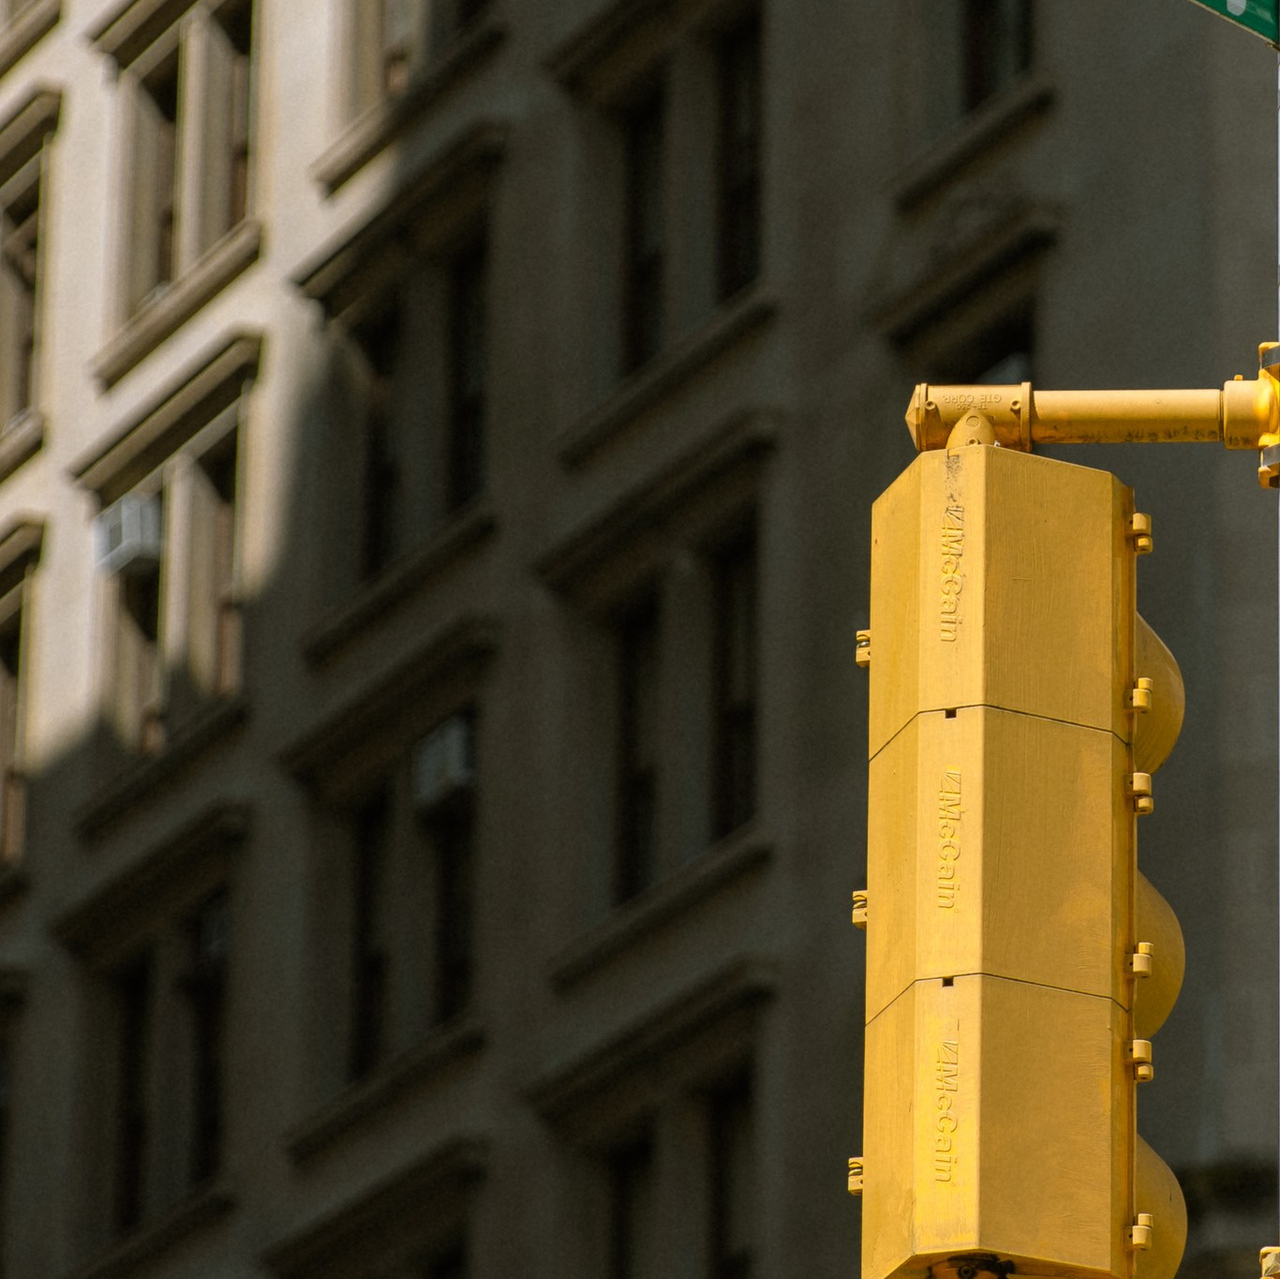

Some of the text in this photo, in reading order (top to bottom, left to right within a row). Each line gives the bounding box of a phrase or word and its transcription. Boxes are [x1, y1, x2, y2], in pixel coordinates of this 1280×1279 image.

[979, 394, 1003, 403] GTE
[939, 530, 966, 642] McCain
[937, 793, 962, 910] McCain
[934, 1065, 960, 1183] McCain
